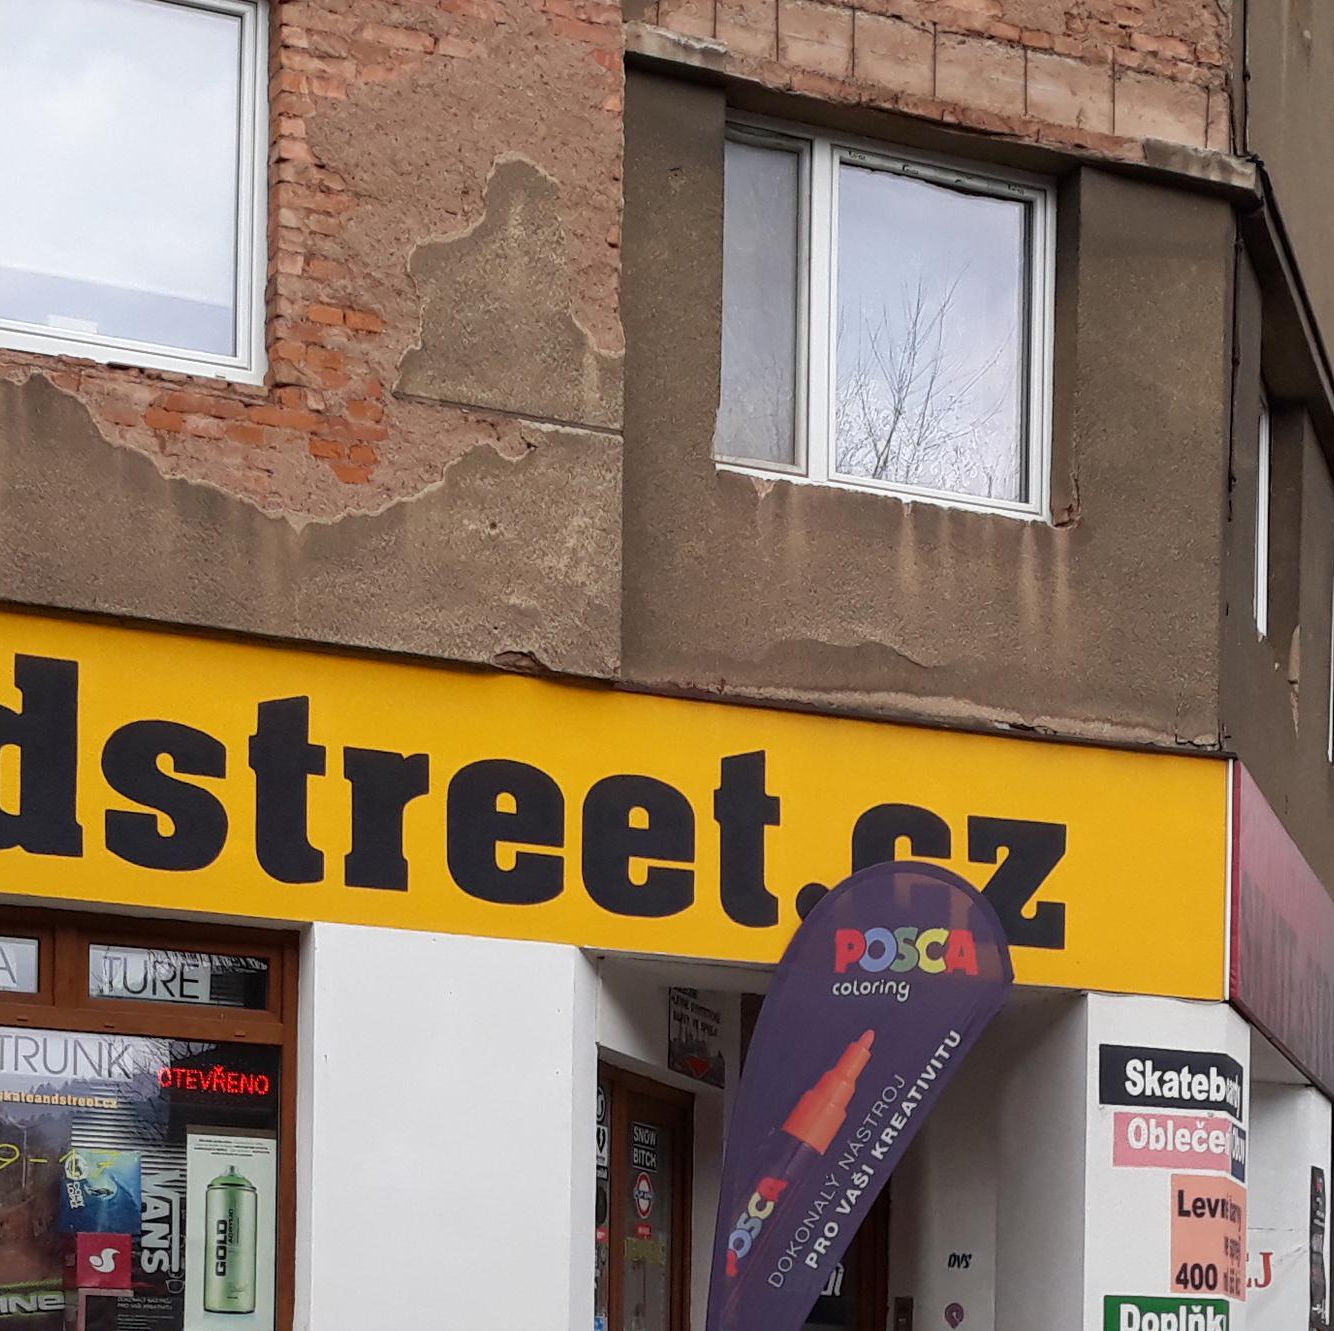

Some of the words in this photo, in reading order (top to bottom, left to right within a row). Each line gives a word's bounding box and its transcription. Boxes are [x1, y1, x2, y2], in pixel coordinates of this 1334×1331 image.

[834, 927, 979, 975] POSCA
[104, 956, 201, 1000] TURE
[831, 979, 910, 1002] coloring
[157, 1064, 270, 1095] OTEVŘENO
[632, 1126, 657, 1147] SNOW
[805, 1220, 838, 1270] PRO
[835, 1163, 875, 1216] VAŠI
[870, 1028, 962, 1161] KREATIVITU
[632, 1148, 657, 1168] BITCH
[768, 1172, 840, 1289] DOKONALÝ
[837, 1073, 907, 1171] NÁSTROJ
[141, 1168, 180, 1274] VANS
[215, 1219, 228, 1277] GOLD
[947, 1252, 972, 1269] DVS
[1175, 1262, 1218, 1291] 400
